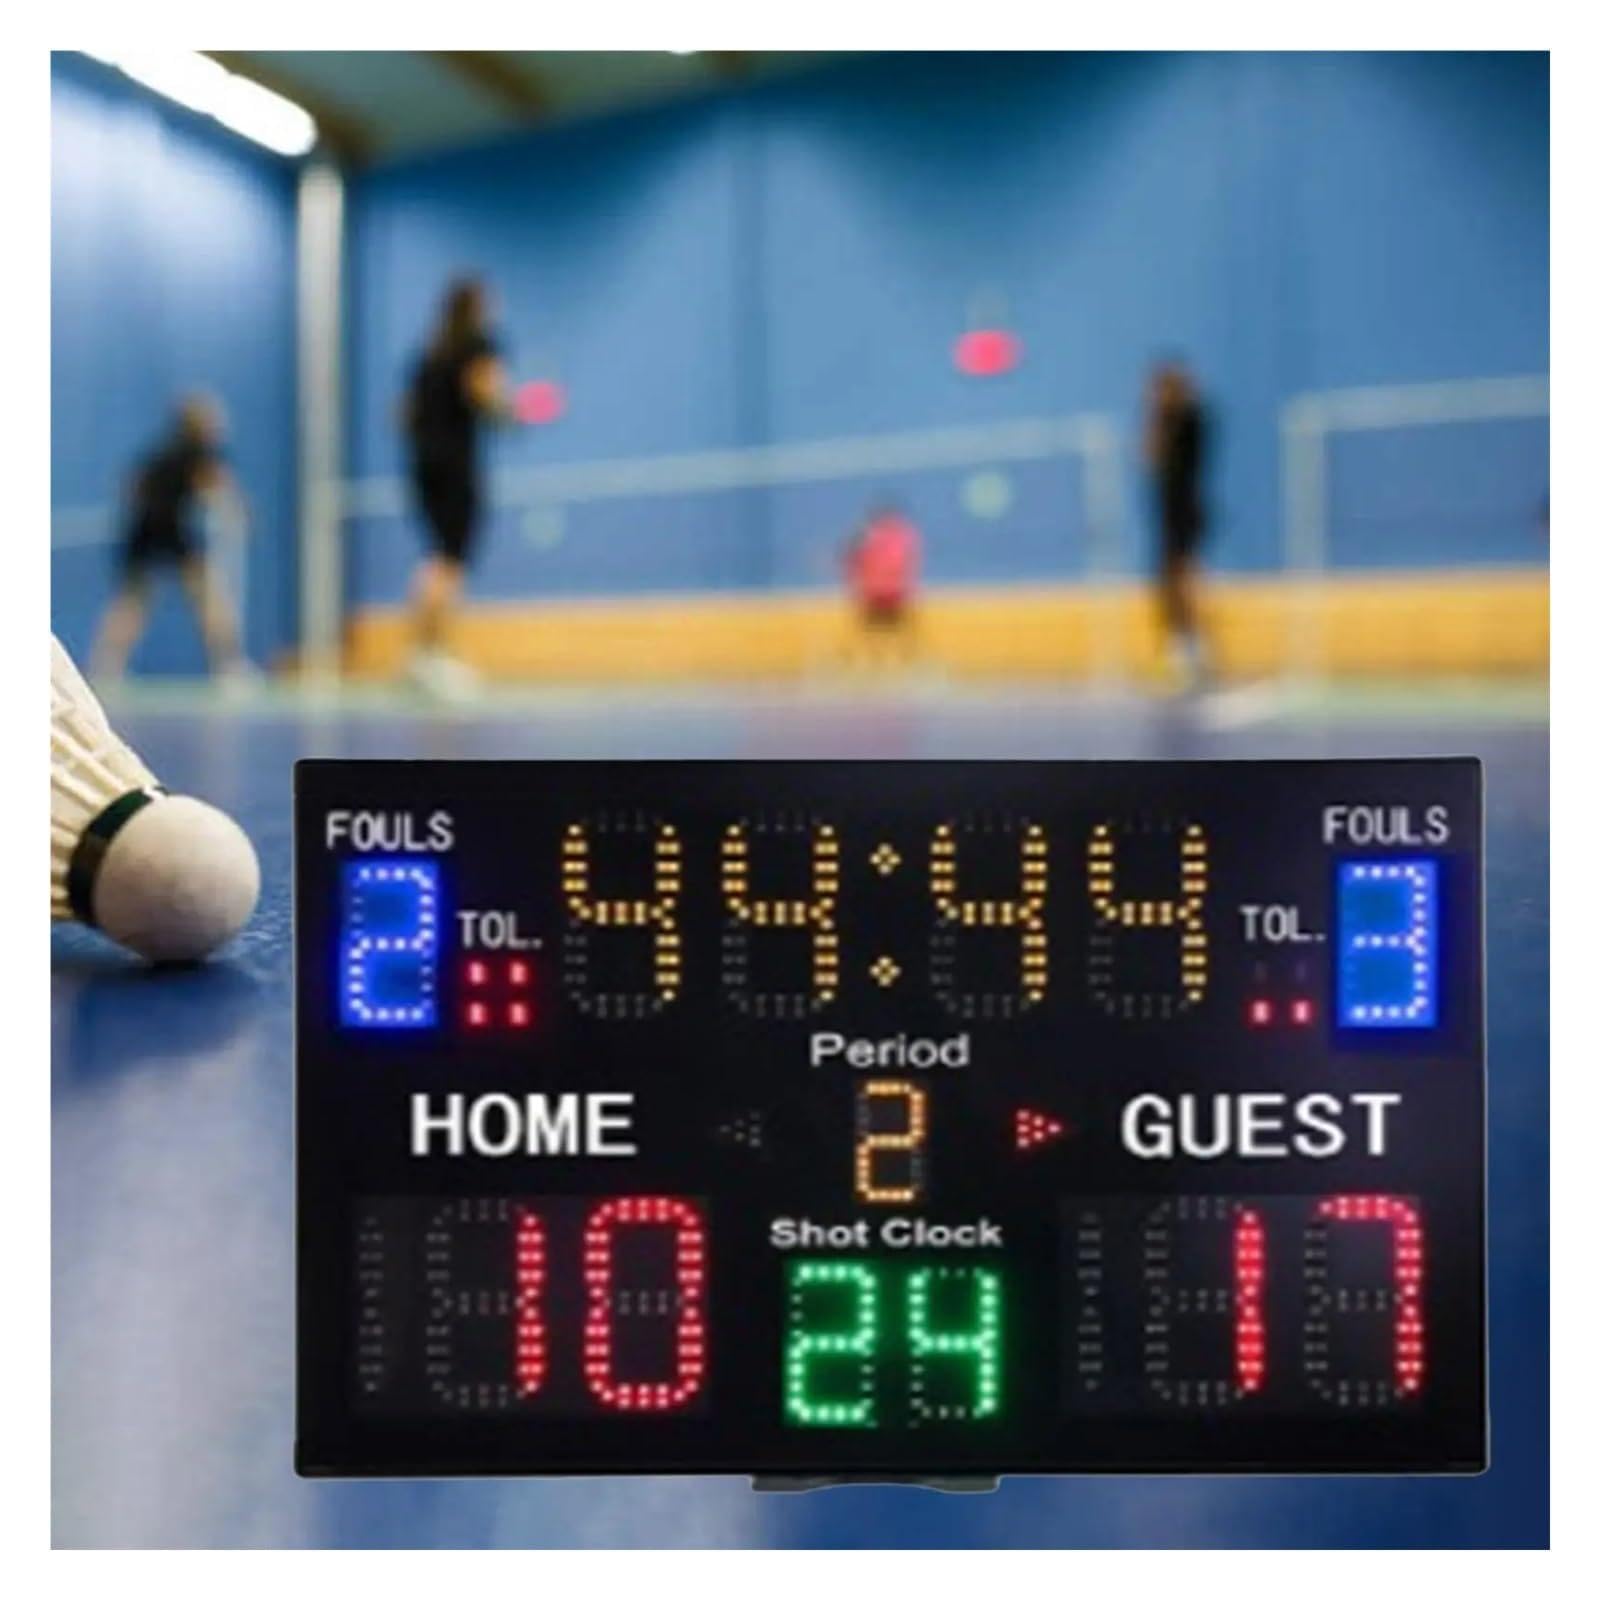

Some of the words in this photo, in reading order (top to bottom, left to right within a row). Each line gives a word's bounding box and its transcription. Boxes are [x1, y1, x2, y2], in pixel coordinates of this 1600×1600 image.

[326, 811, 455, 851] FOULS
[1323, 806, 1449, 845] FOULS
[347, 866, 435, 1021] 2
[457, 911, 543, 950] TOL.
[1240, 906, 1326, 942] TOL.
[1351, 865, 1428, 1020] 3
[811, 1033, 970, 1068] Period
[411, 1093, 638, 1156] HOME
[855, 1081, 927, 1202] 2
[1121, 1093, 1401, 1157] GUEST
[769, 1218, 870, 1249] Shot
[881, 1218, 1003, 1249] Clock
[516, 1197, 706, 1410] 10
[1235, 1196, 1423, 1393] 17
[787, 1262, 997, 1425] 24
